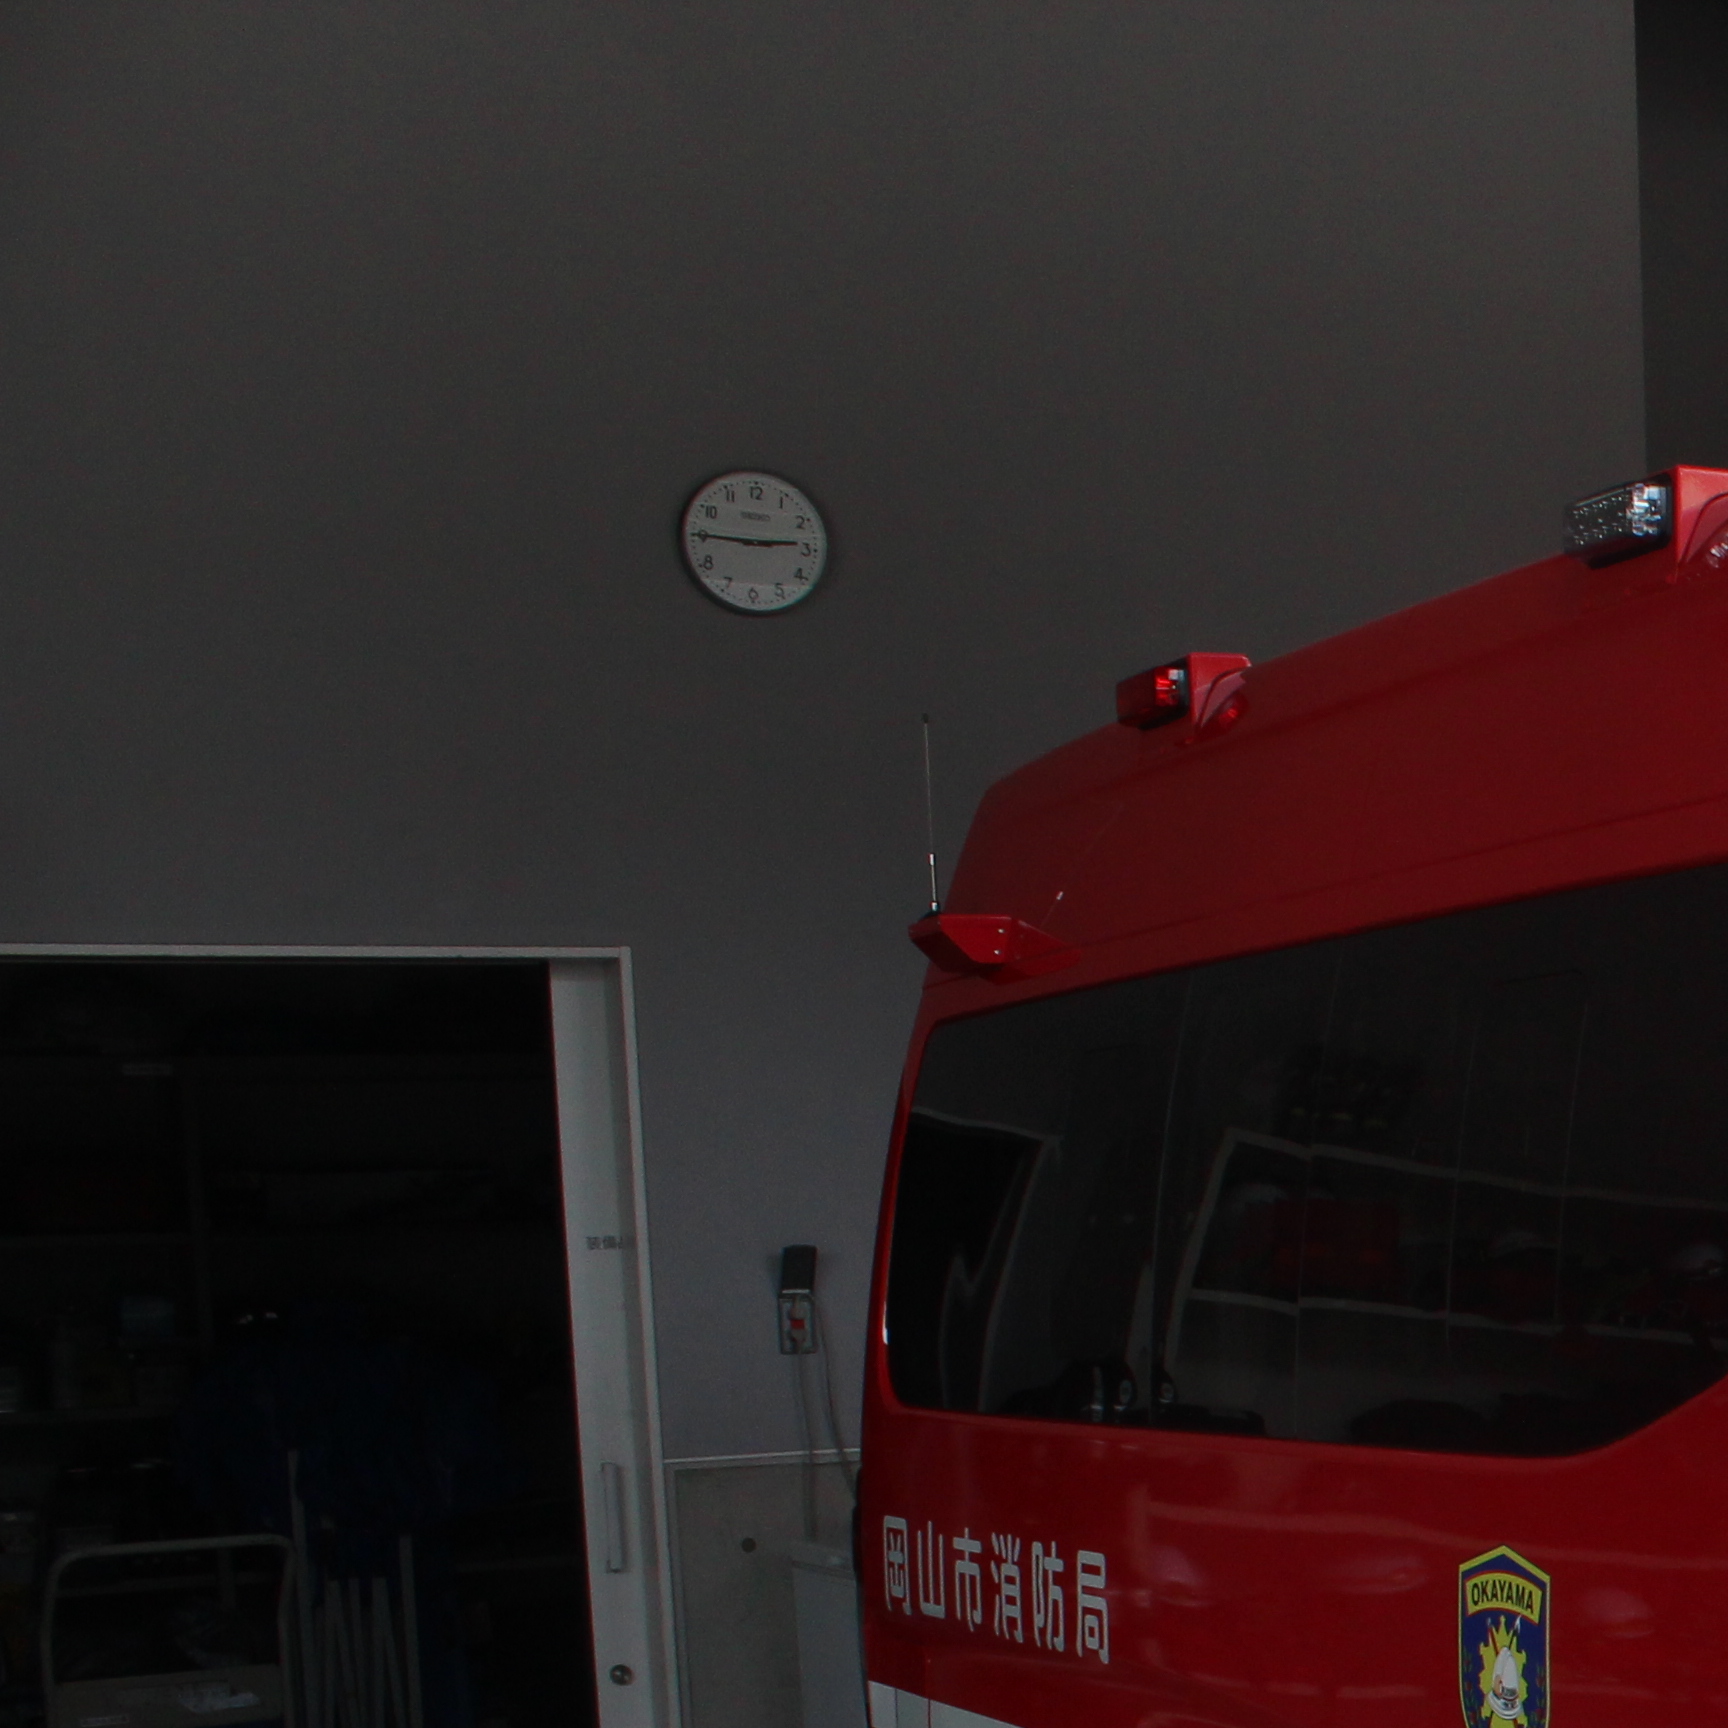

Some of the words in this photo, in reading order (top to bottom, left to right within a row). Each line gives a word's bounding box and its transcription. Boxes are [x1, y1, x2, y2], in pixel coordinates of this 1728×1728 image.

[726, 490, 735, 502] 11
[749, 486, 763, 500] 12
[705, 505, 717, 519] 10
[795, 515, 805, 529] 2
[801, 542, 811, 557] 3
[703, 555, 714, 570] 8
[793, 567, 808, 581] 4
[723, 576, 733, 588] 7
[748, 588, 759, 600] 6
[774, 582, 785, 599] 5
[882, 1514, 1110, 1665] 岡山市消防局
[1470, 1578, 1534, 1615] OKAYAMA
